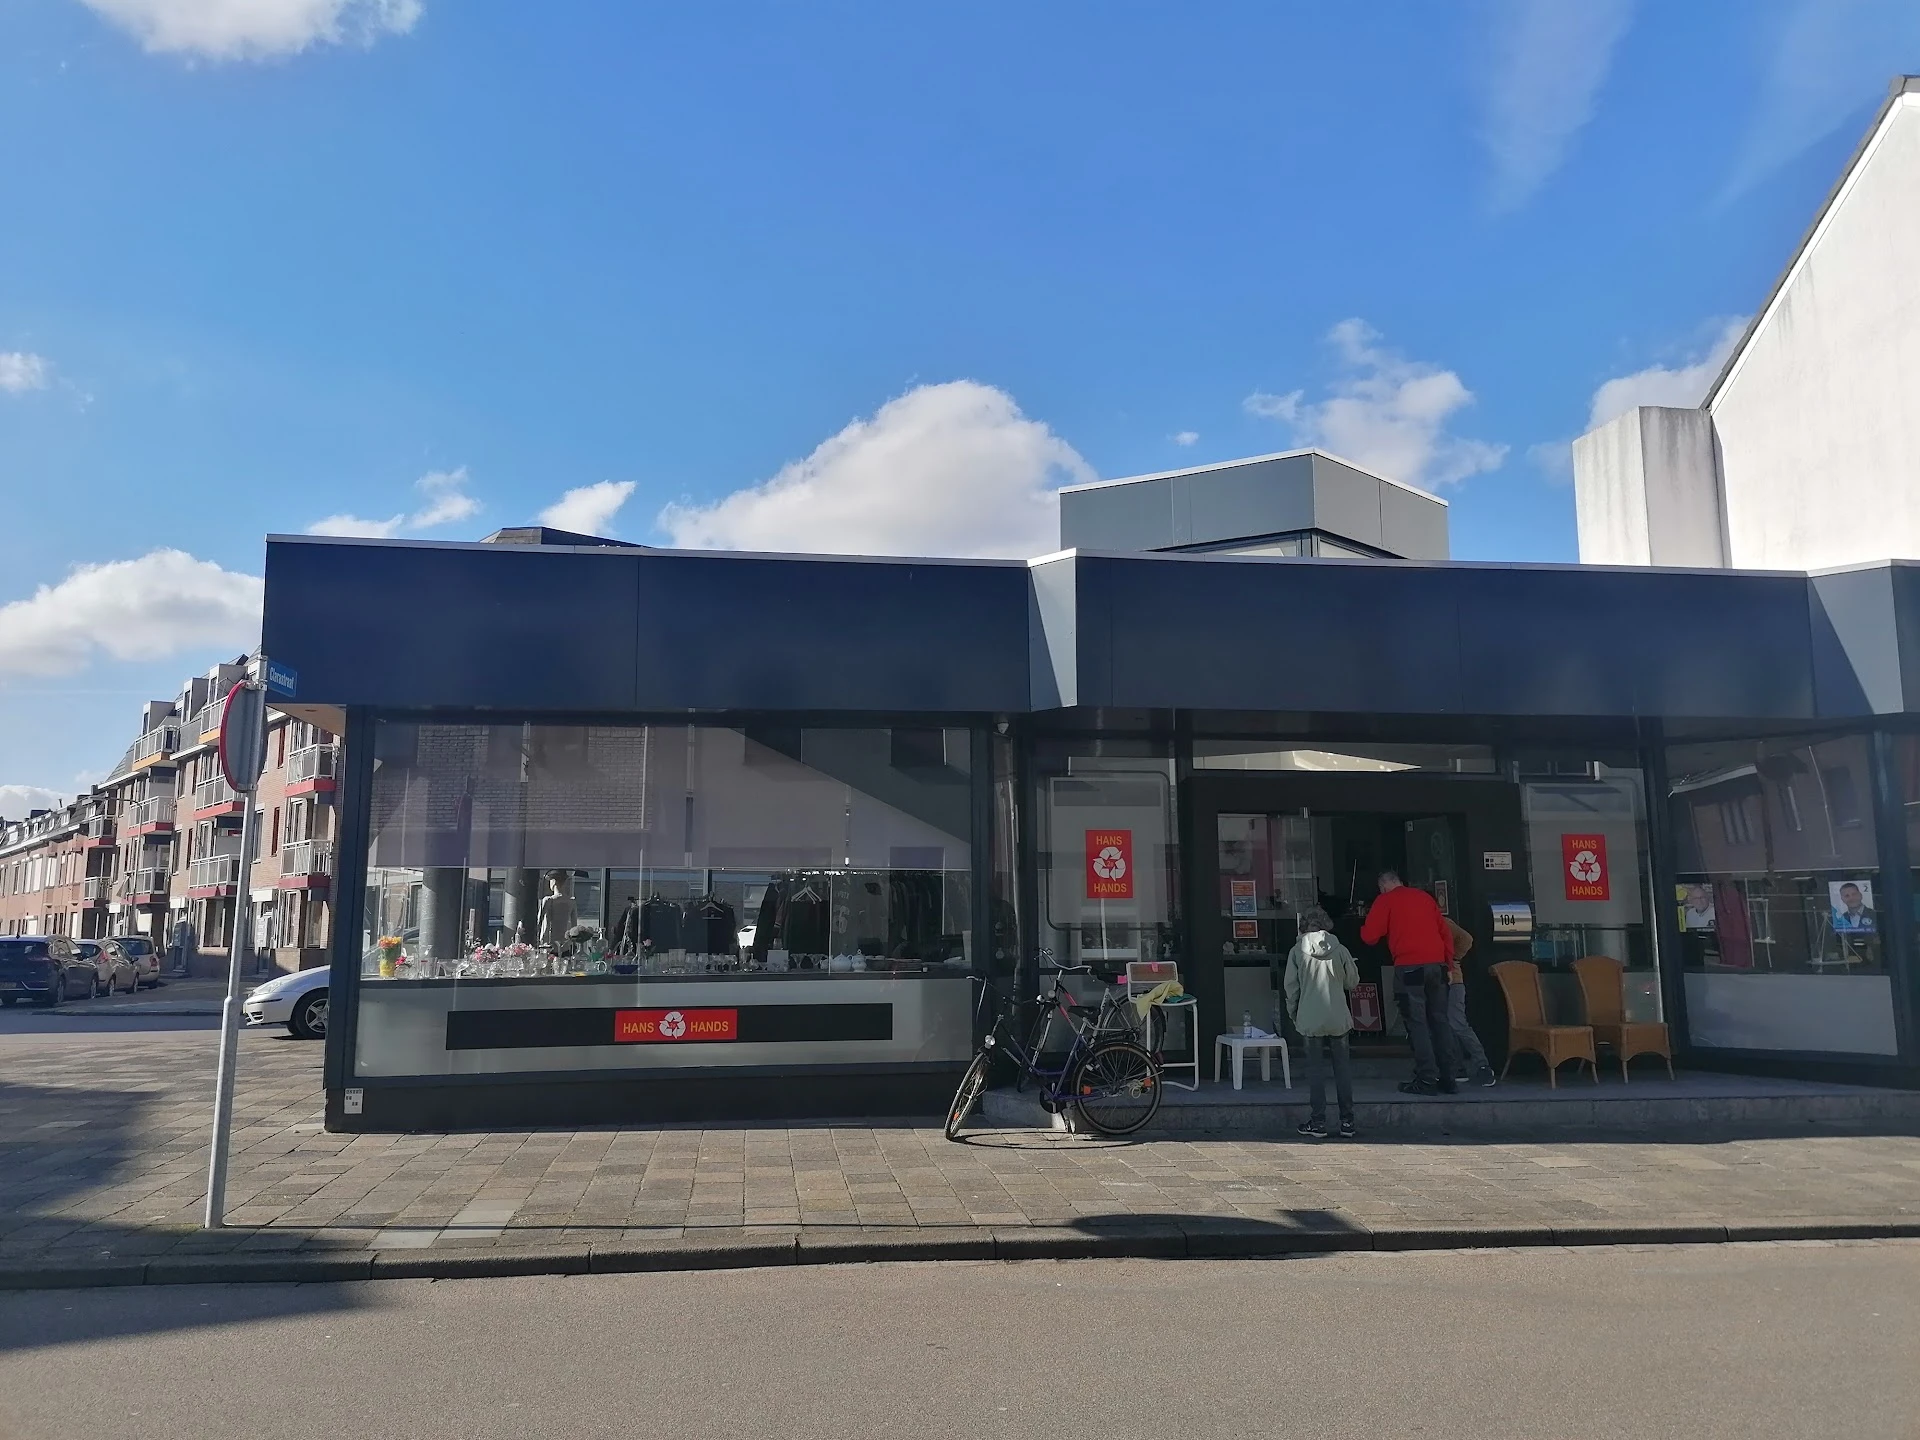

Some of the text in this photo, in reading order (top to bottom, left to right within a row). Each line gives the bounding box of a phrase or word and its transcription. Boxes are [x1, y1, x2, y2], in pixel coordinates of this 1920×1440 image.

[270, 667, 294, 690] Clarastraat
[1096, 836, 1123, 846] HANS
[1572, 840, 1597, 849] HANS
[1094, 883, 1127, 893] HANDS
[1572, 886, 1603, 896] HANDS
[1863, 885, 1869, 893] 2
[1500, 914, 1516, 926] 104
[623, 1022, 655, 1034] HANS
[690, 1021, 729, 1033] HANDS
